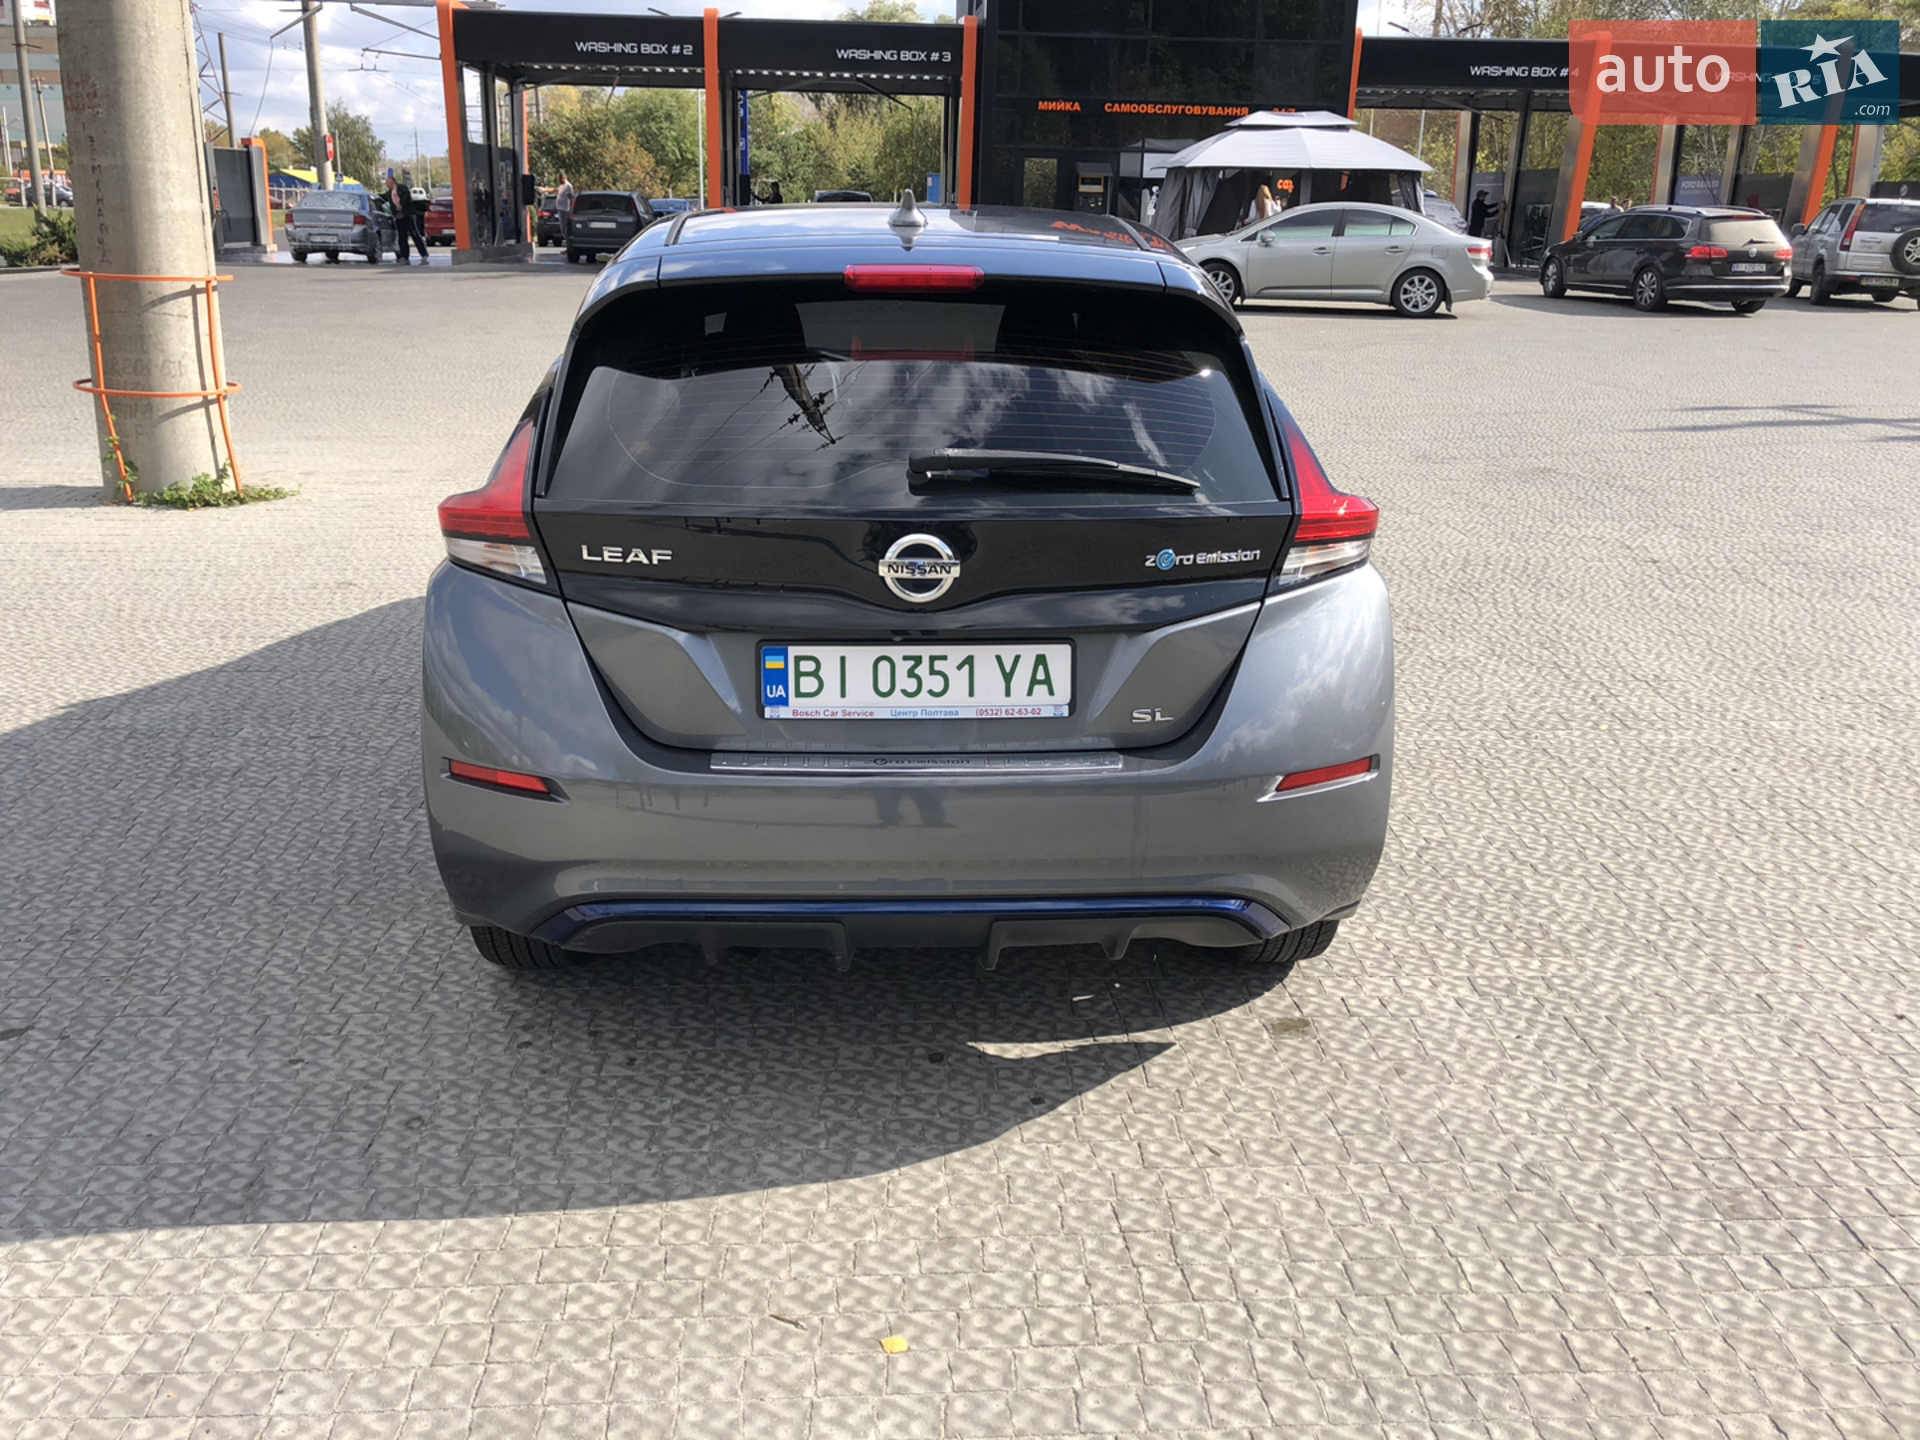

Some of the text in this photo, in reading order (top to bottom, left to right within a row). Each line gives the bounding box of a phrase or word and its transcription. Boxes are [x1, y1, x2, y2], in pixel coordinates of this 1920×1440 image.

[575, 41, 638, 54] WASHING
[640, 43, 668, 55] BOX
[682, 44, 693, 55] 2
[836, 49, 898, 61] WASHING
[899, 50, 927, 61] BOX
[941, 51, 952, 62] 3
[1470, 66, 1529, 77] WASHING
[1531, 66, 1558, 77] BOX
[1570, 67, 1580, 77] 4
[1038, 100, 1081, 112] МИЙКА
[1104, 103, 1249, 116] САМООБСЛУГОВУВАННЯ
[581, 545, 673, 565] LEAF
[1196, 549, 1261, 565] Emission
[887, 564, 952, 575] NISSAN
[794, 653, 1055, 698] BI 0351 YA
[766, 685, 786, 698] UA
[792, 709, 875, 717] Bosch Car Service
[890, 708, 959, 718] Центр Полтава
[975, 707, 1002, 717] (0532)
[1004, 707, 1042, 716] 62-63-02
[1132, 707, 1174, 723] SL
